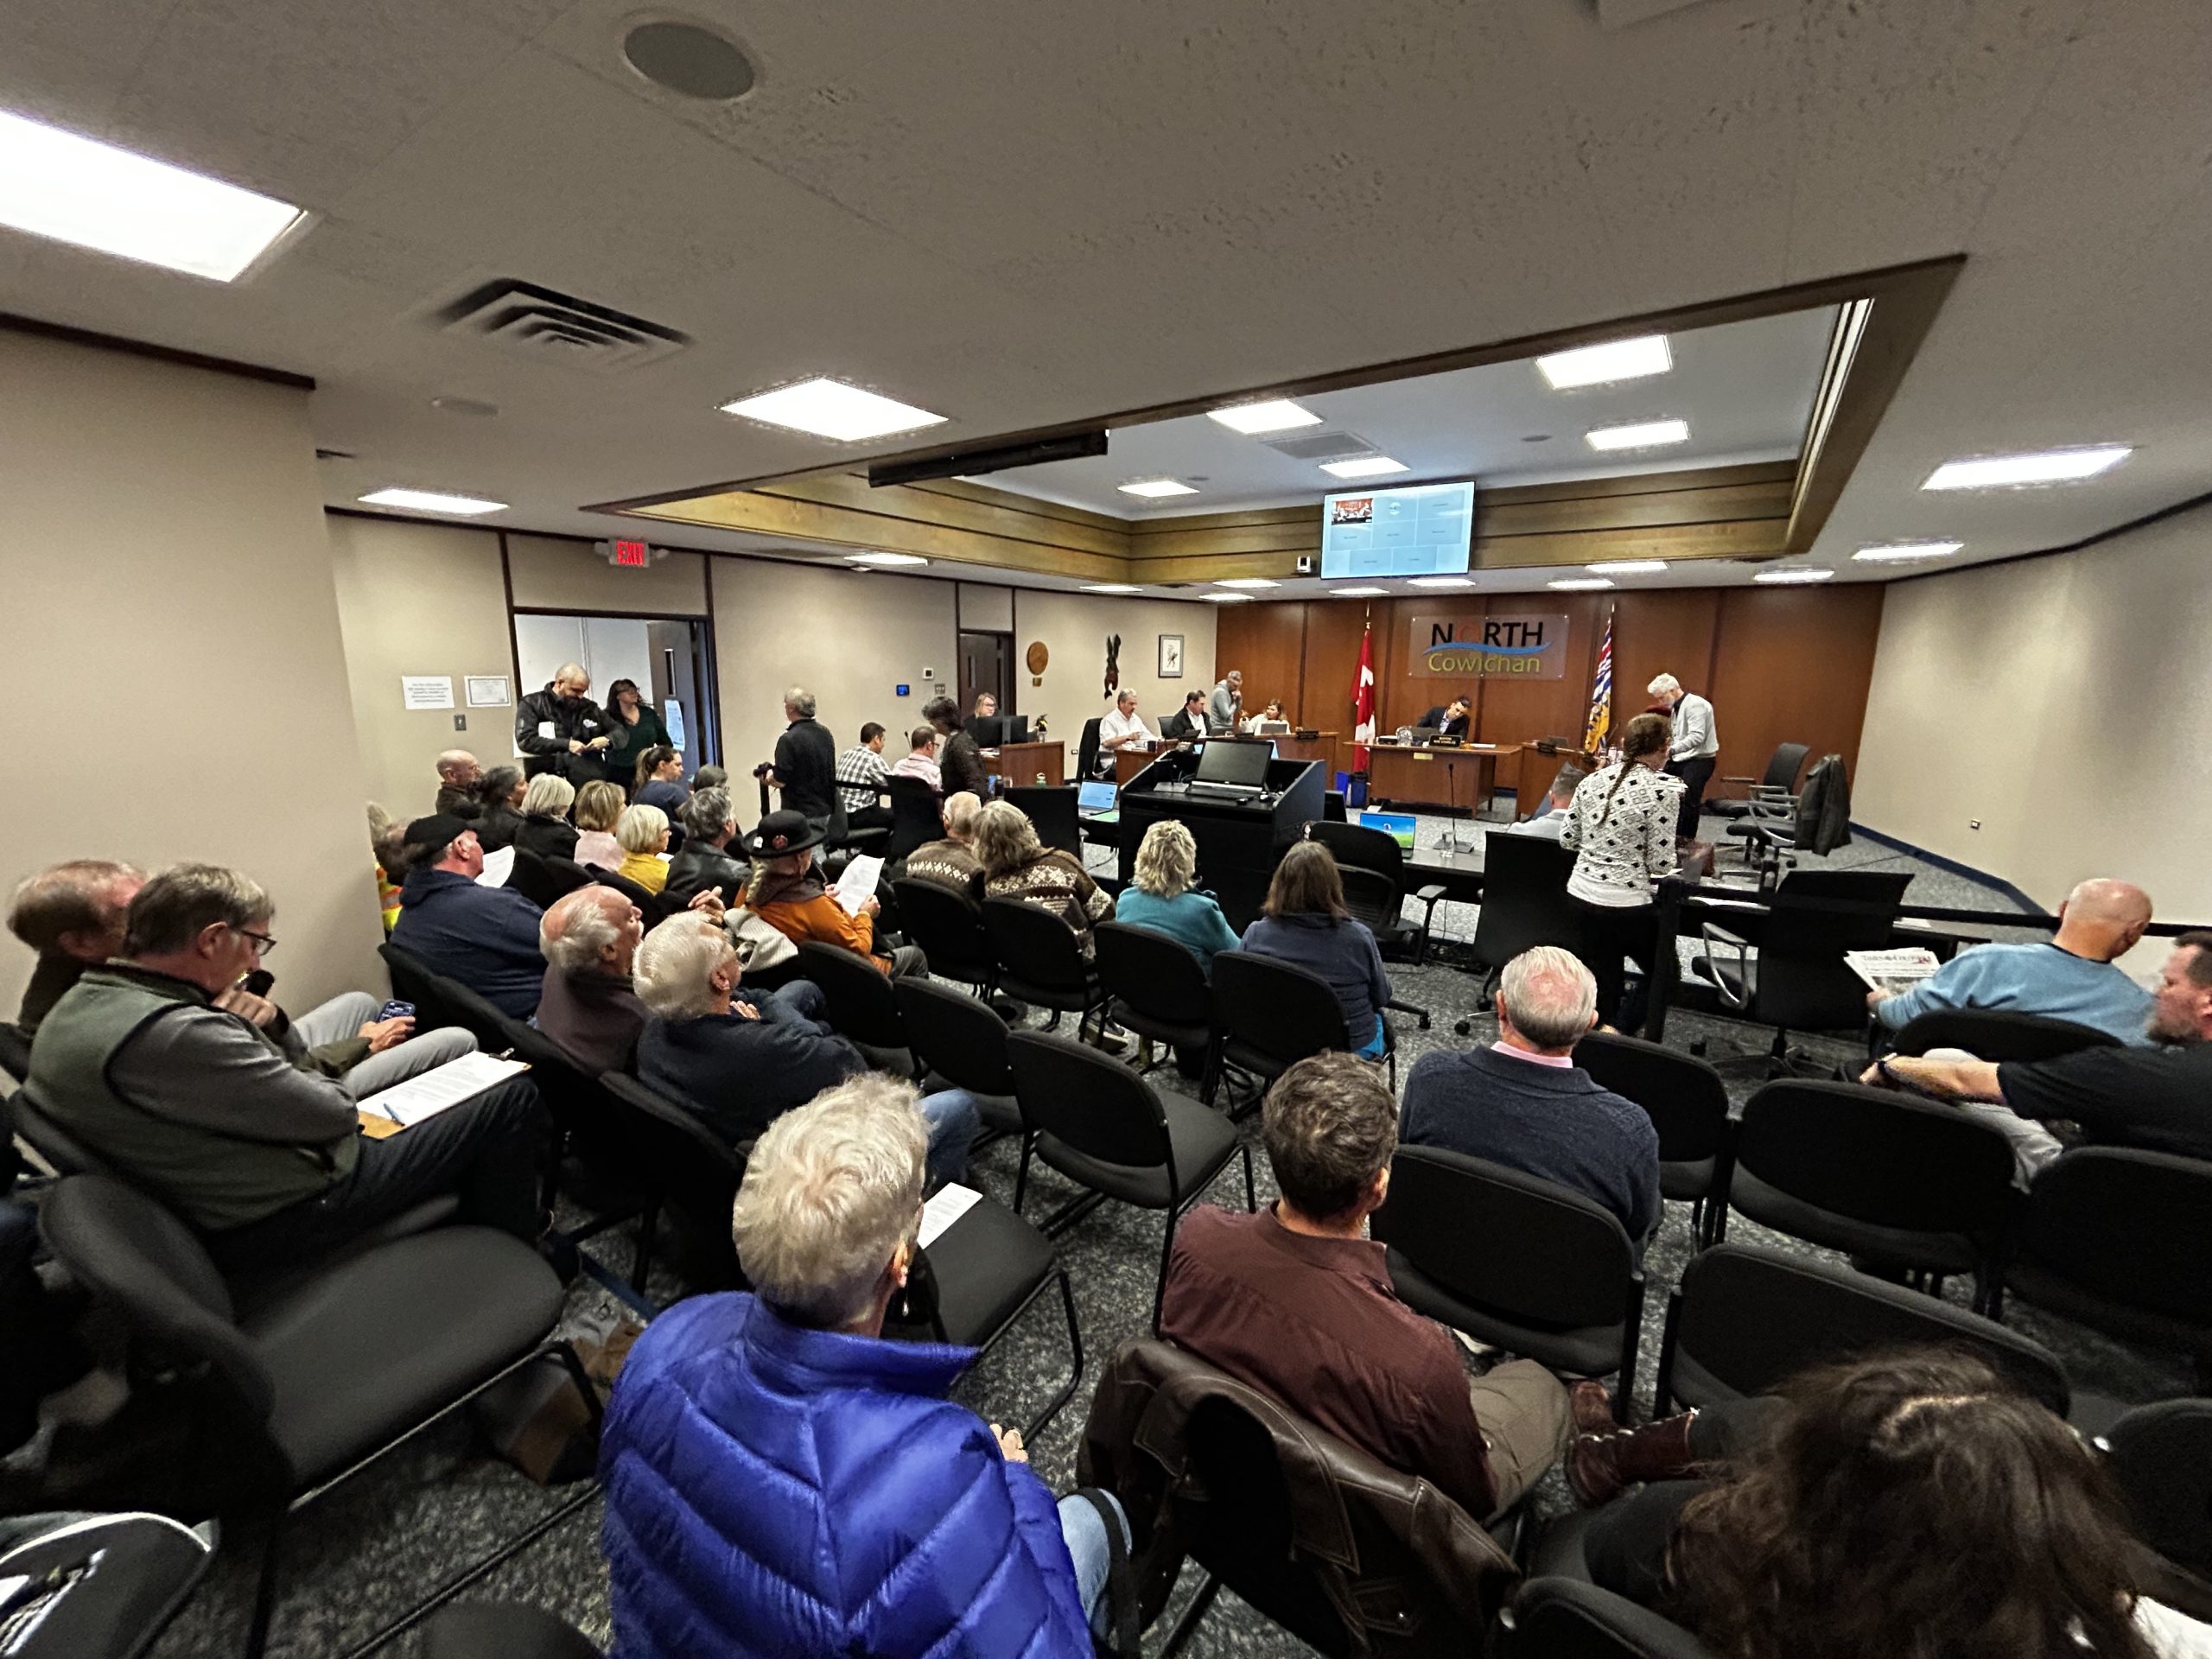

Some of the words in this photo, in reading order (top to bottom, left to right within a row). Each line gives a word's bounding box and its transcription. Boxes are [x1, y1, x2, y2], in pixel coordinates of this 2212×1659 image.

[617, 540, 644, 567] EXIT
[1431, 621, 1544, 648] NORTH
[1427, 652, 1541, 673] Cowichan
